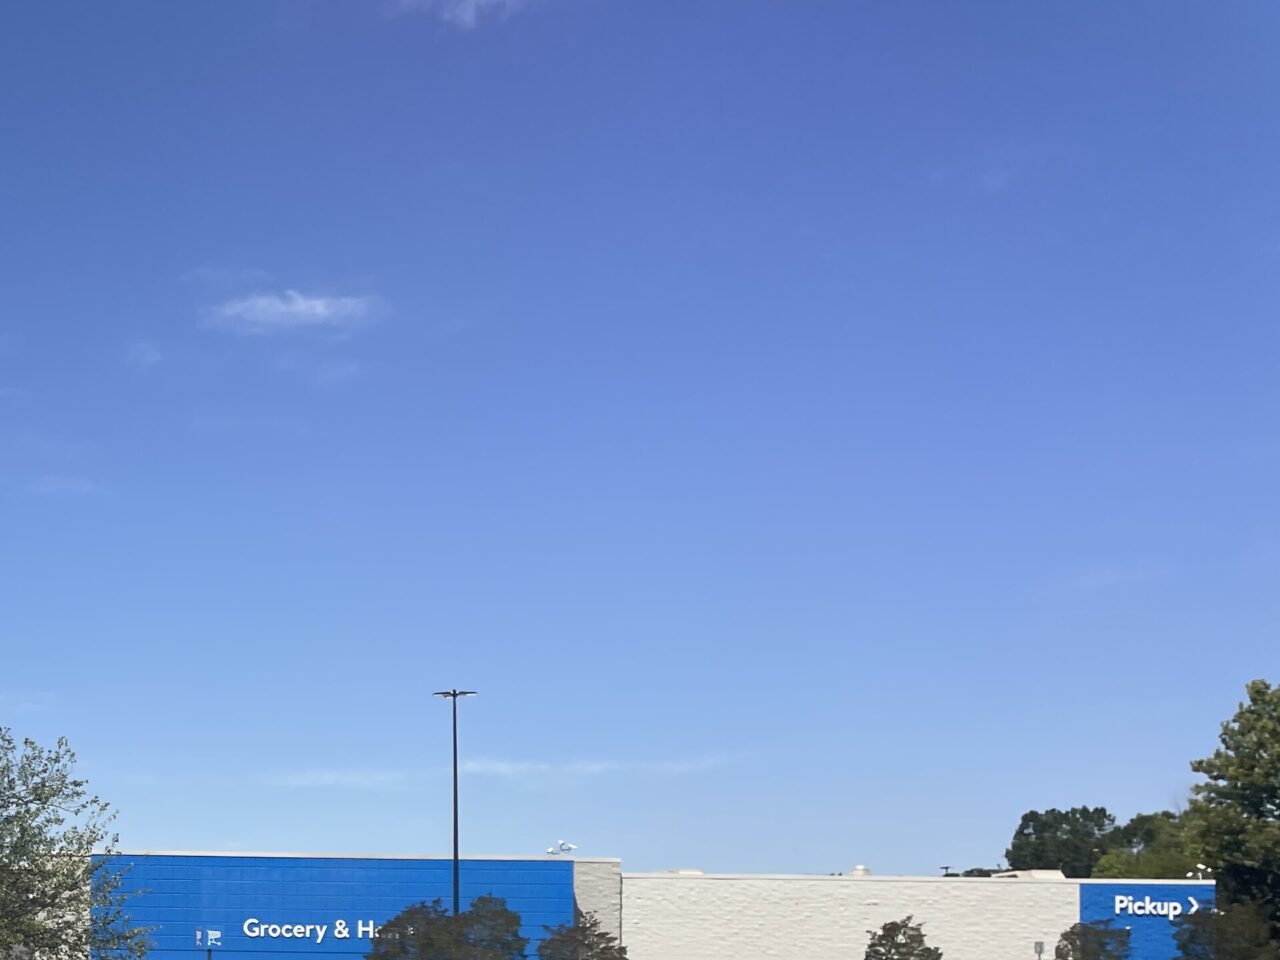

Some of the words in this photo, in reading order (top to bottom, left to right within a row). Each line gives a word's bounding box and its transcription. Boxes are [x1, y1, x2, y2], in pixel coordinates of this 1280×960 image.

[1114, 895, 1182, 921] Pickup
[243, 918, 327, 943] Grocery
[334, 919, 350, 939] &
